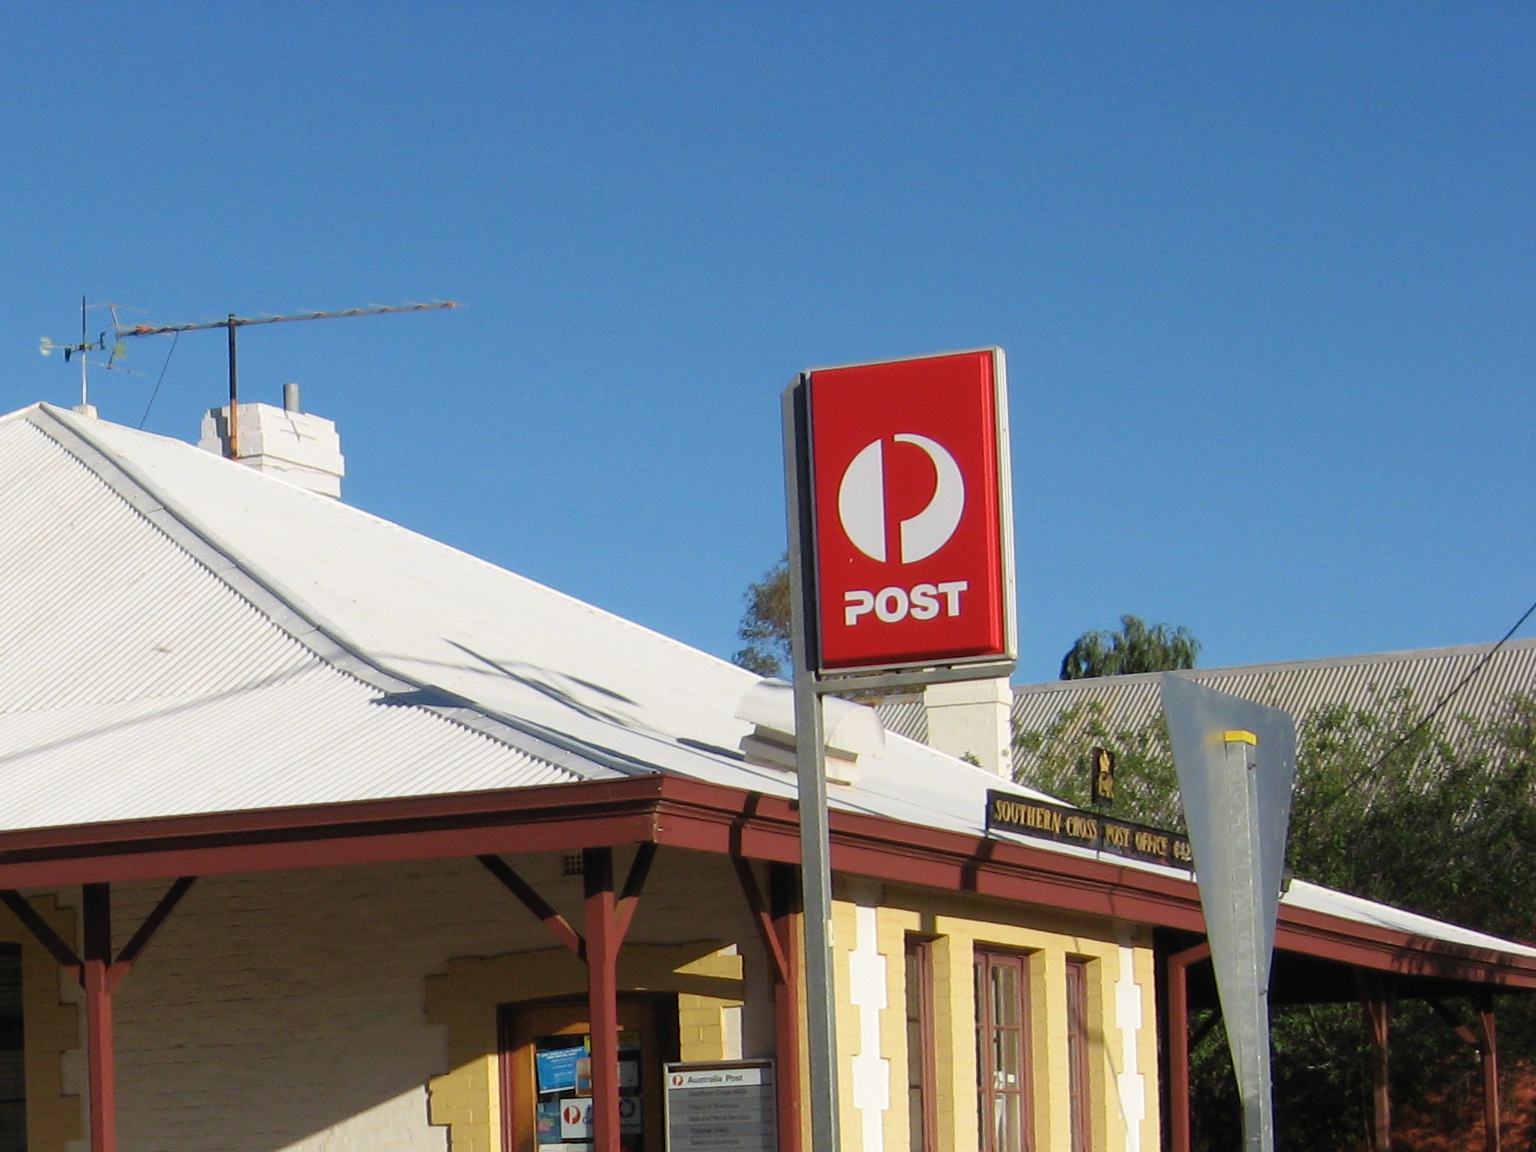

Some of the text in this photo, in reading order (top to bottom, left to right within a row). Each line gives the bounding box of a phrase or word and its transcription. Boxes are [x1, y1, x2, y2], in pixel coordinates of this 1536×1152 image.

[843, 581, 968, 626] POST
[994, 799, 1063, 834] SOUTHERN
[1067, 817, 1097, 839] CROSS
[1106, 825, 1130, 846] POST
[1136, 832, 1167, 855] OFFICE
[687, 1073, 743, 1084] Australia Post
